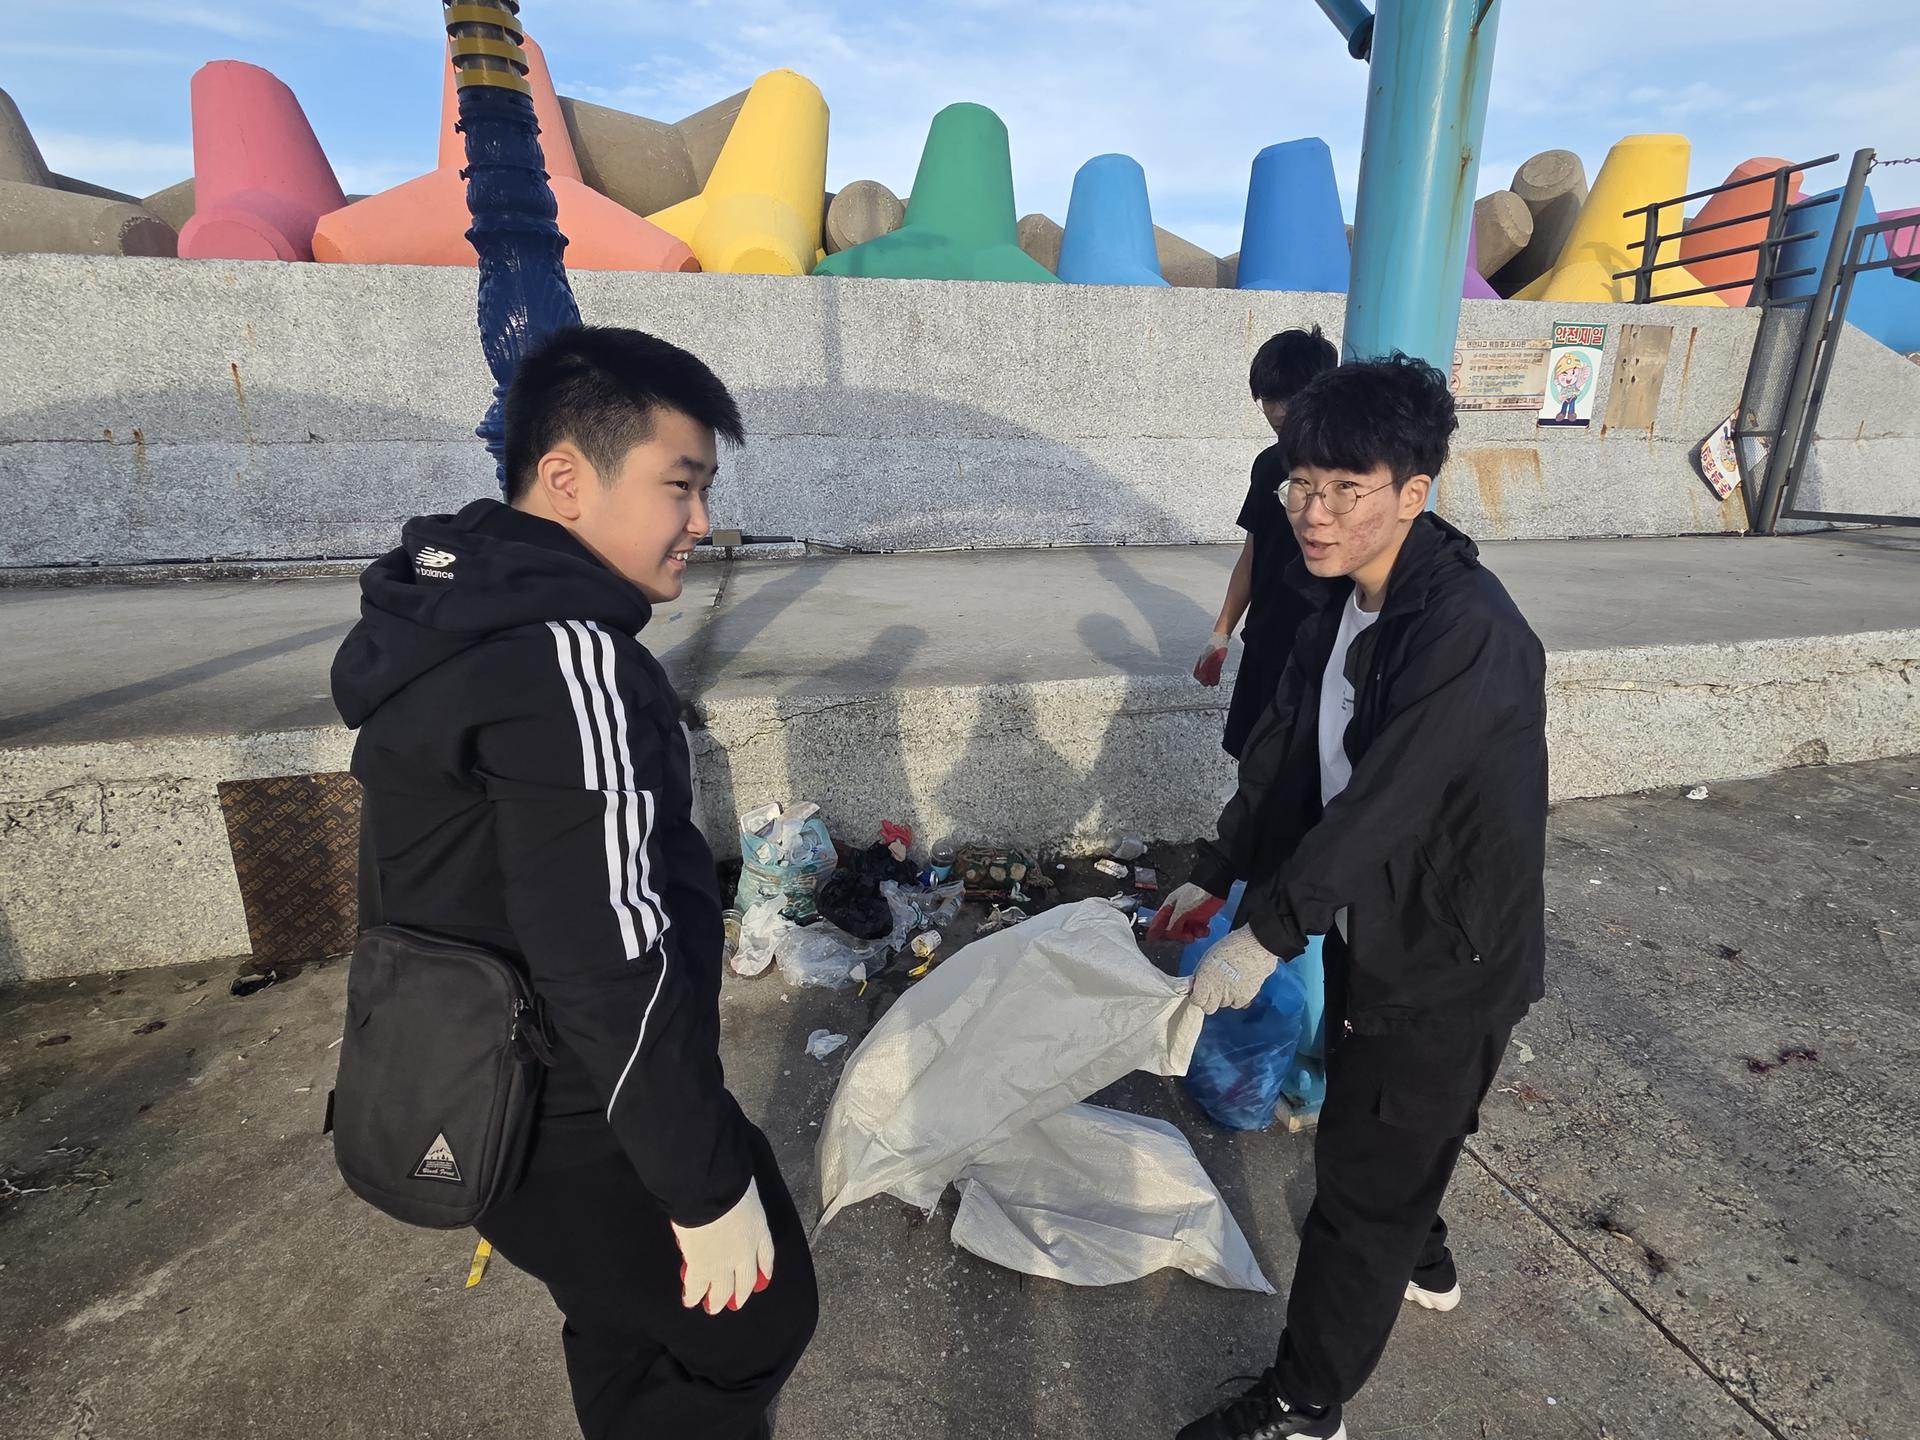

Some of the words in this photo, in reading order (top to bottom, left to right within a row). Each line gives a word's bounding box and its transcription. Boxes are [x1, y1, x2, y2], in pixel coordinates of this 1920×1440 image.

[1555, 326, 1604, 345] 안전제일
[421, 567, 454, 579] balance
[298, 775, 359, 826] 동일산업(주)
